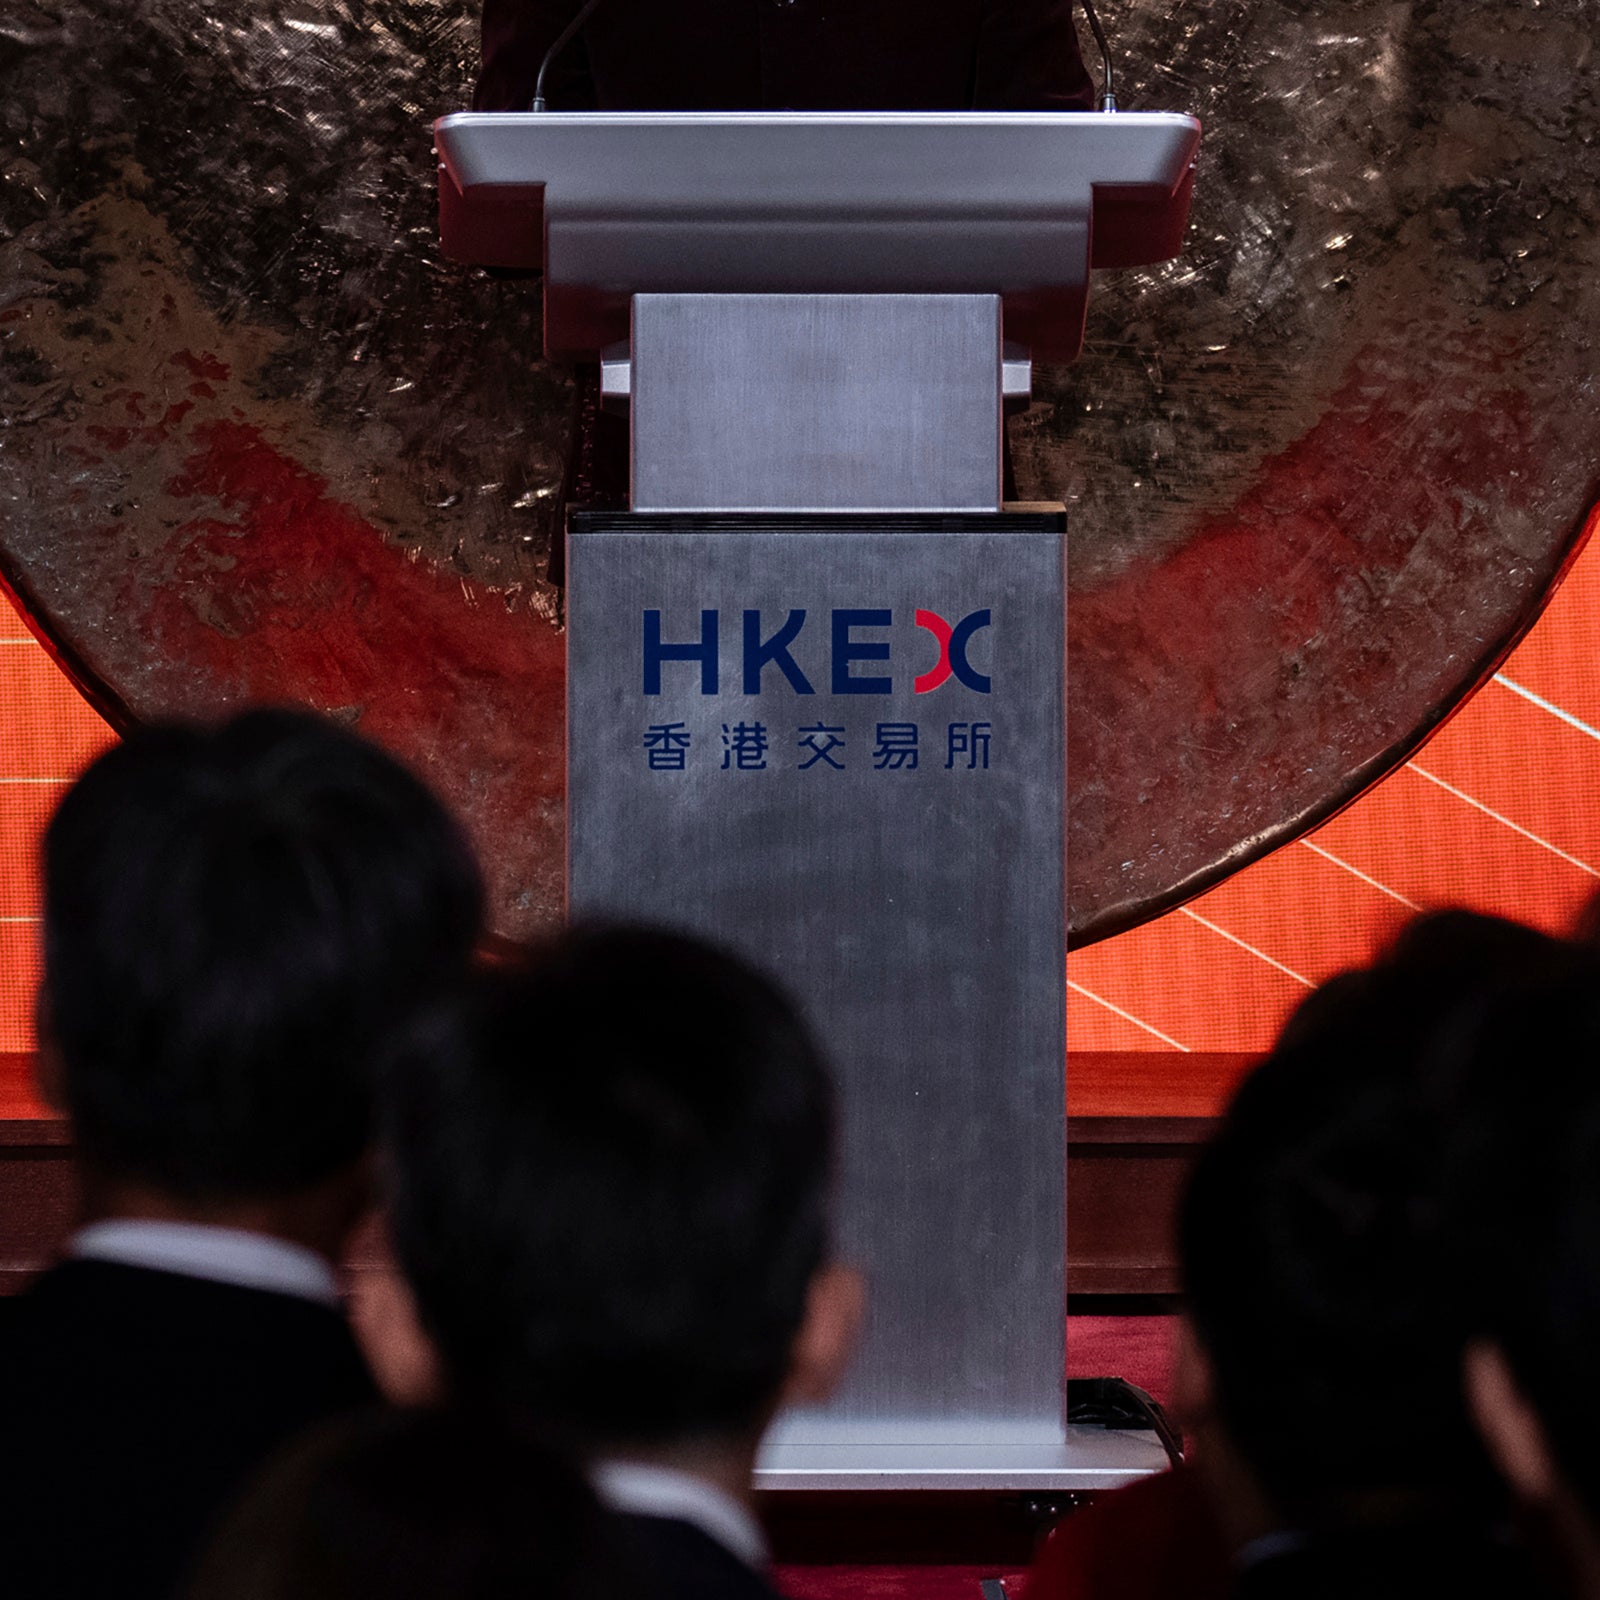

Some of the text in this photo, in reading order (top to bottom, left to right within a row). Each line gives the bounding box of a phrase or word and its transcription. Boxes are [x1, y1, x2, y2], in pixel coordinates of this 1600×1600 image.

[642, 608, 991, 695] HKEX
[642, 721, 991, 770] 香港交易所
